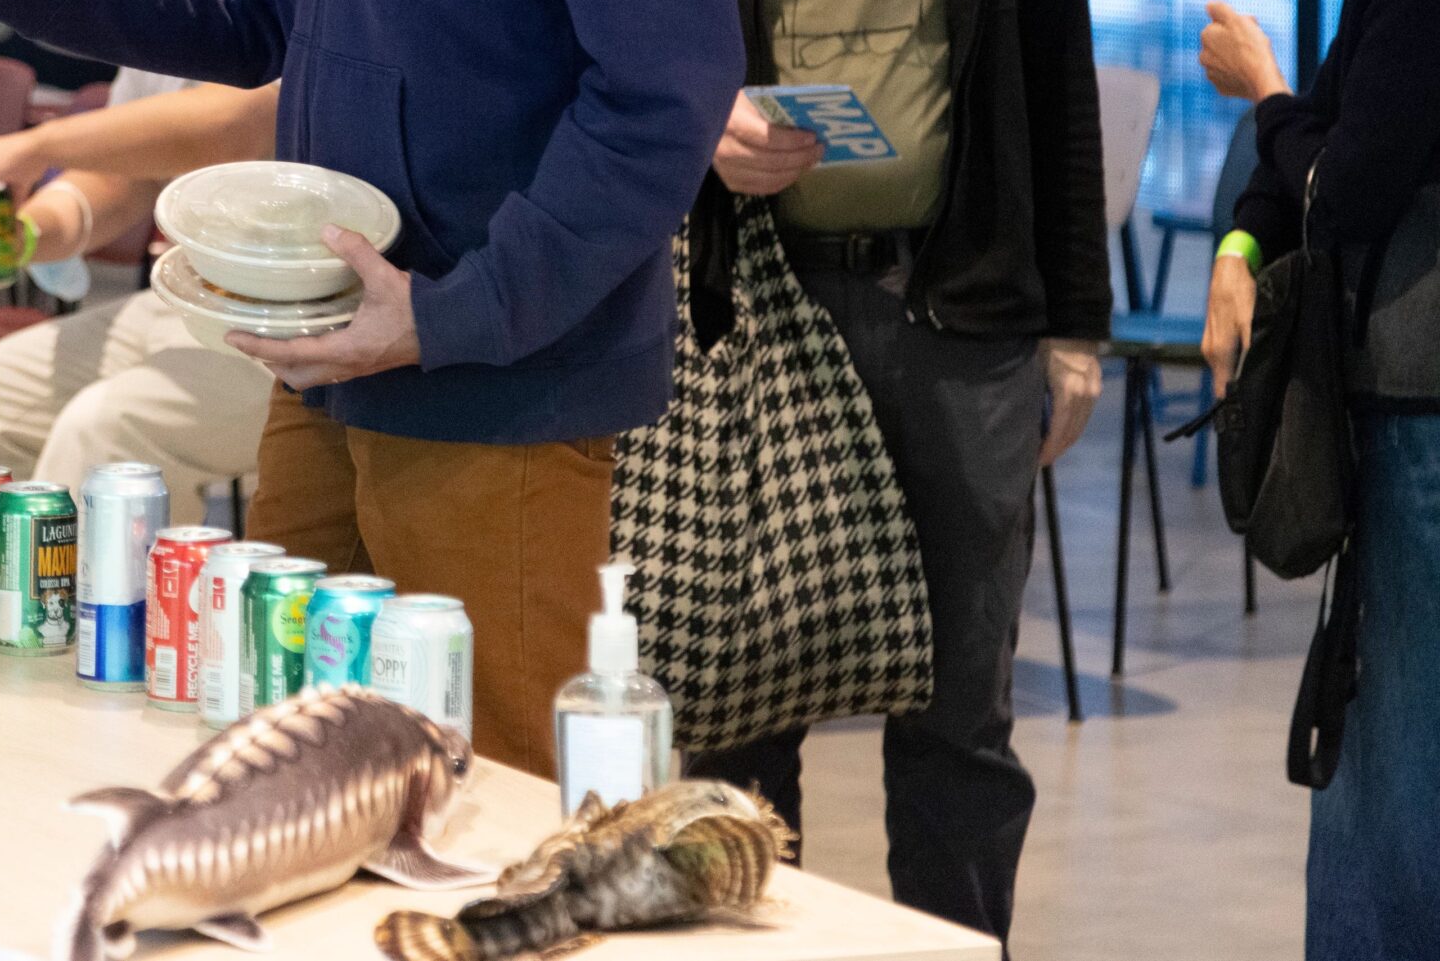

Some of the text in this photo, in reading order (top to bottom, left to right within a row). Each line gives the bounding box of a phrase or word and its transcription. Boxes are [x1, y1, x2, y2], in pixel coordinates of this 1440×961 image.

[794, 92, 889, 156] MAP
[187, 621, 199, 699] RECYCLE ME
[372, 655, 408, 679] OPPY
